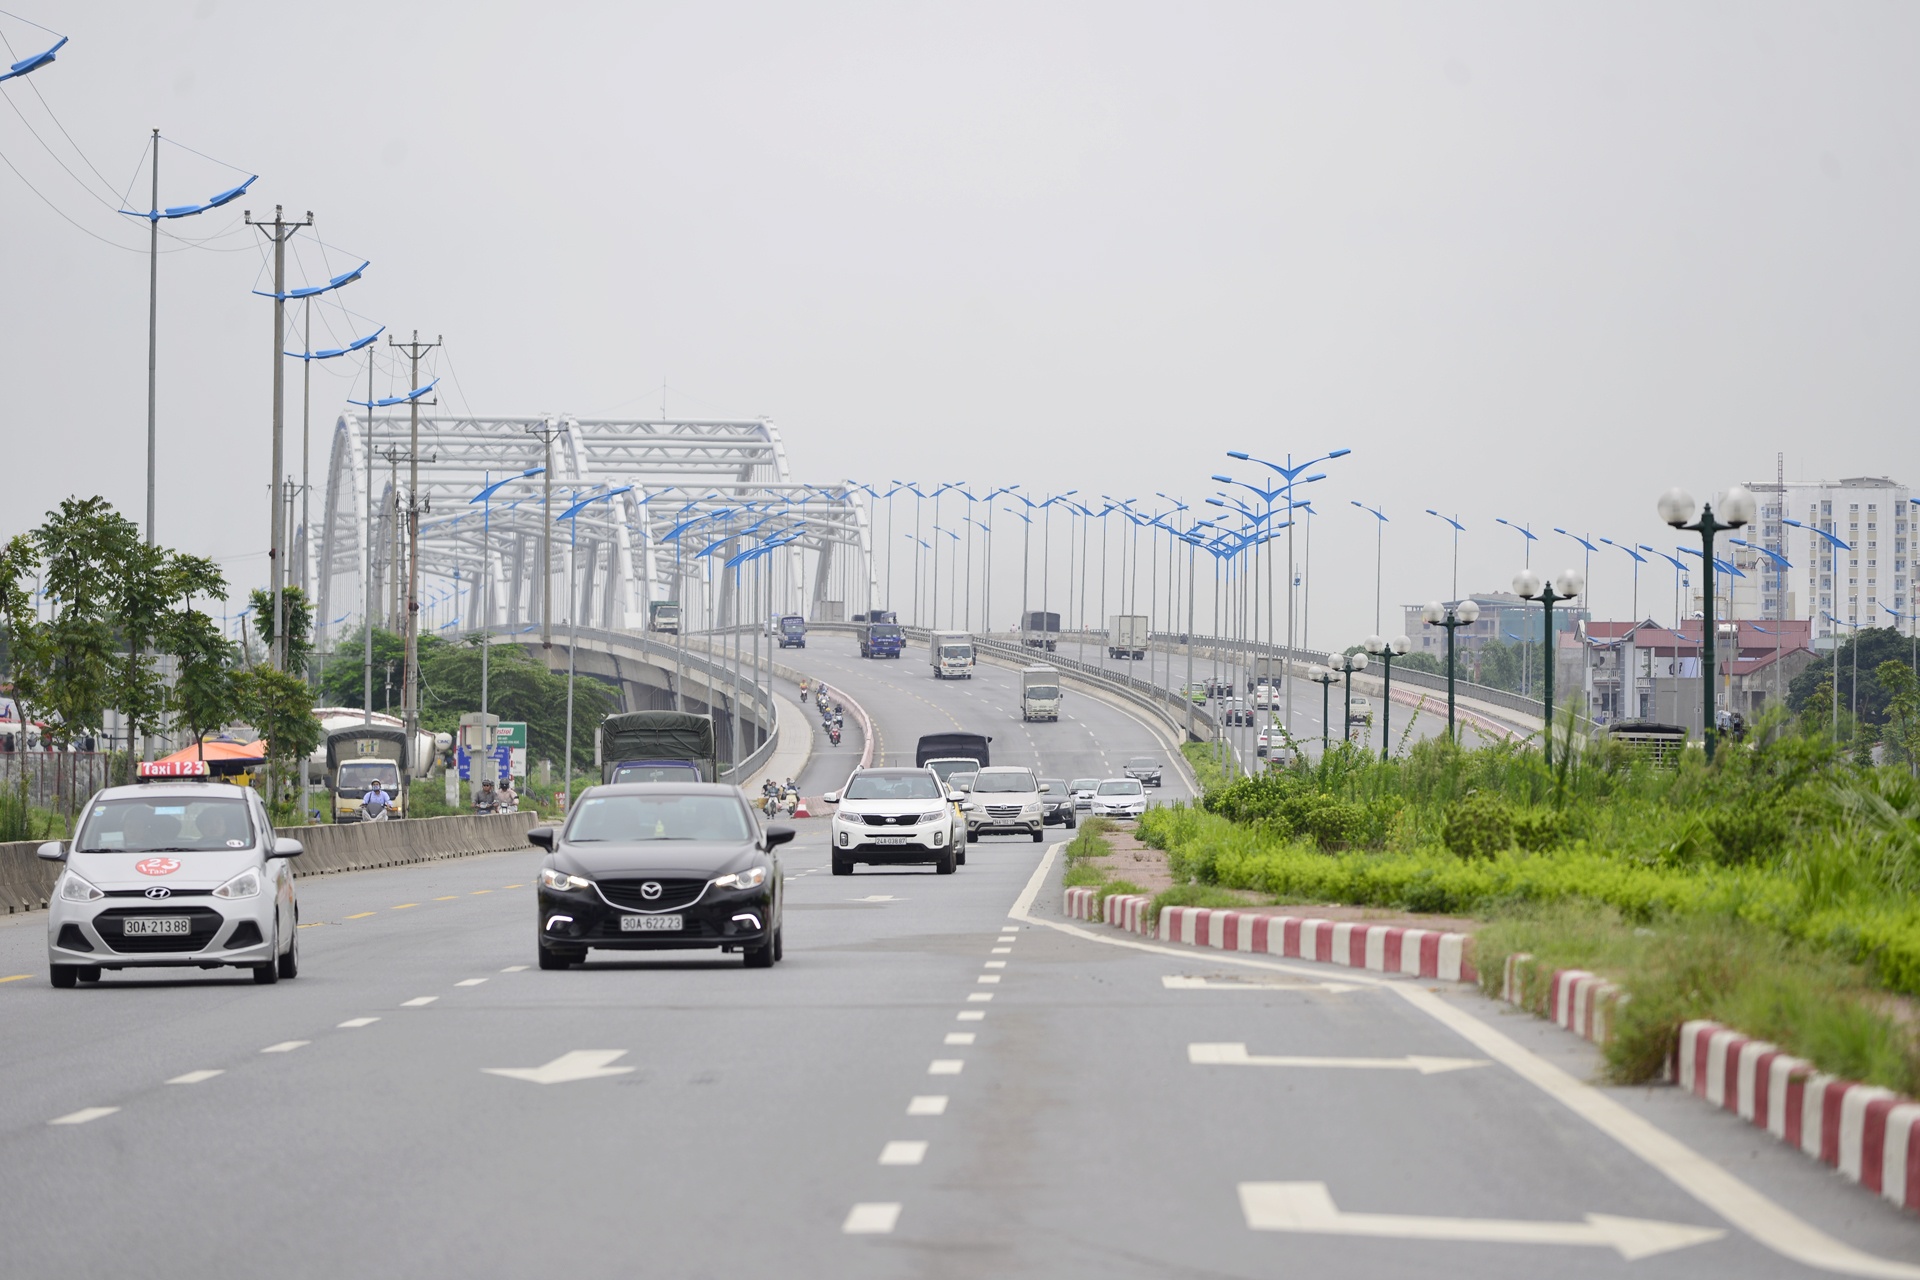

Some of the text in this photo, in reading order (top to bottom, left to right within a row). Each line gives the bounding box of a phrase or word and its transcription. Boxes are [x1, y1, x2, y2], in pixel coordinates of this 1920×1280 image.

[143, 761, 171, 775] Taxi
[139, 858, 181, 872] 123
[126, 920, 188, 933] 30A-213.88
[623, 917, 681, 930] 30A-62223
